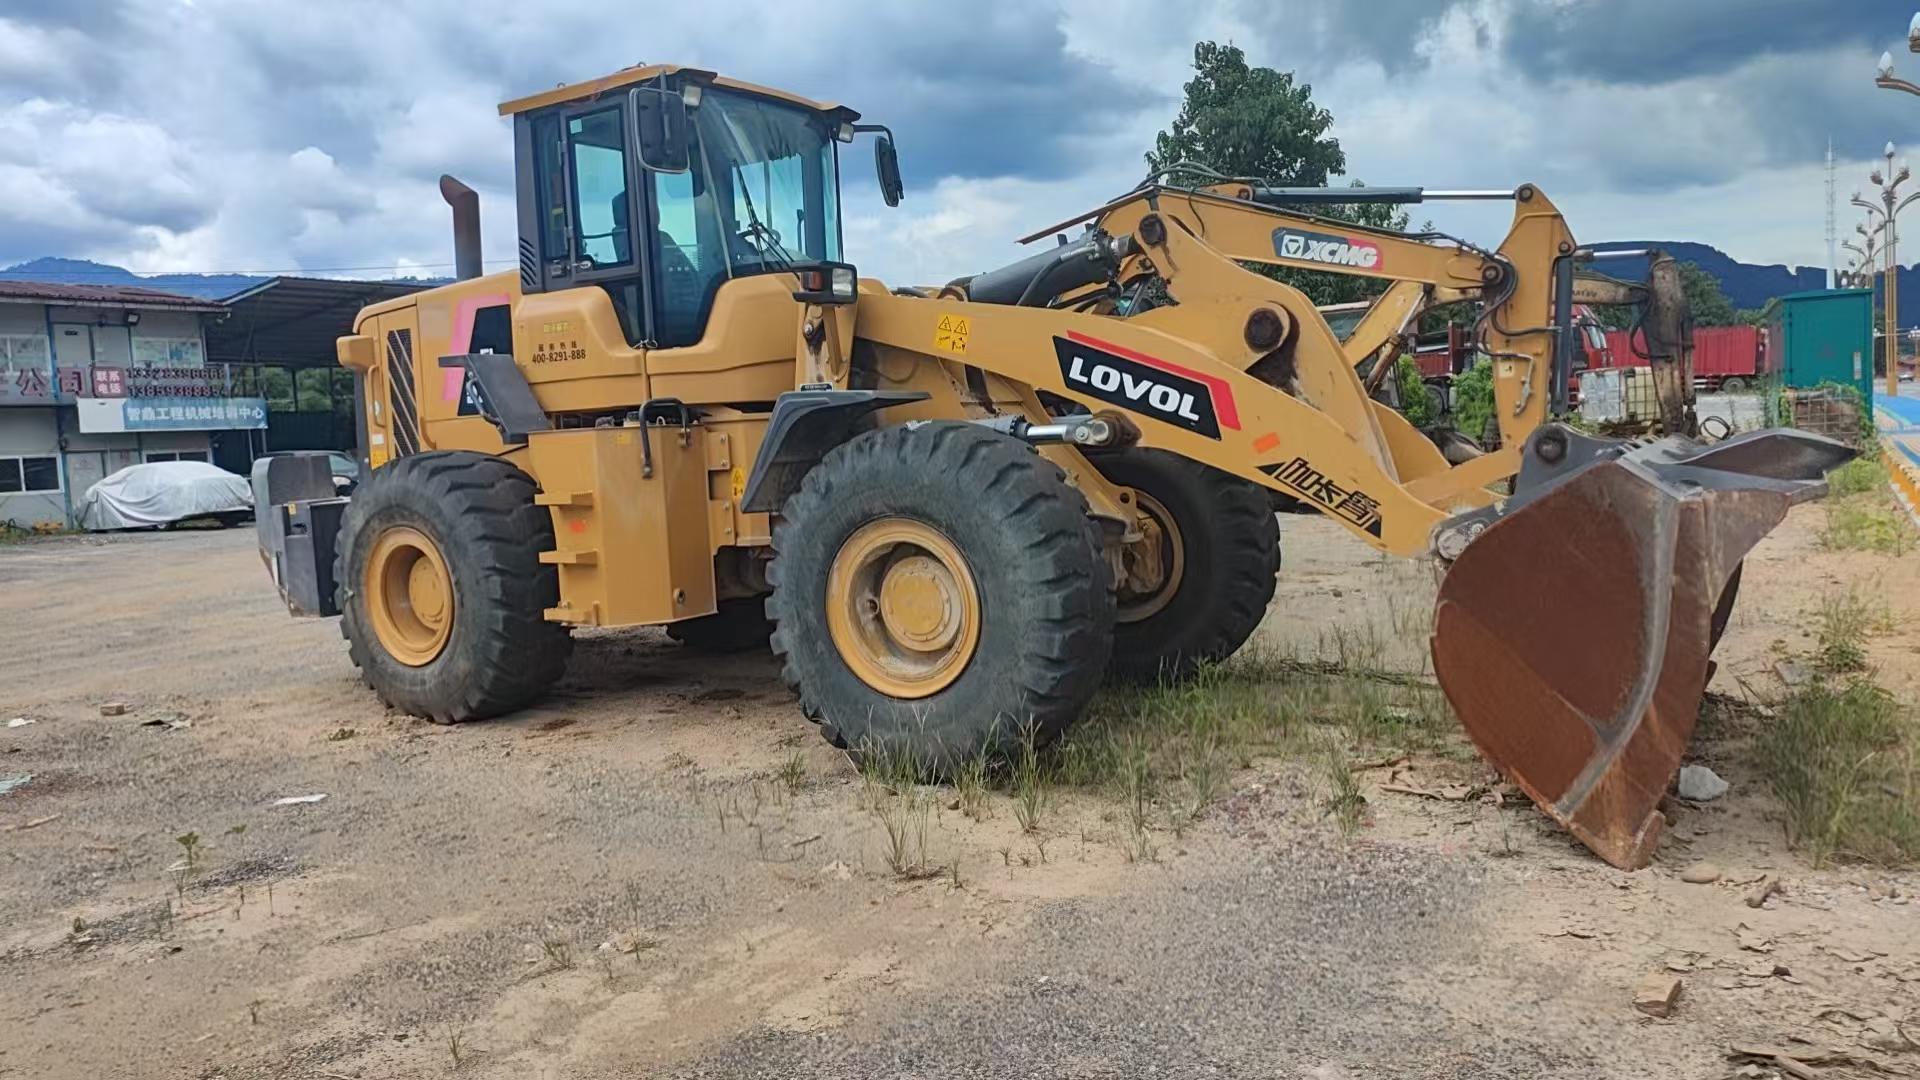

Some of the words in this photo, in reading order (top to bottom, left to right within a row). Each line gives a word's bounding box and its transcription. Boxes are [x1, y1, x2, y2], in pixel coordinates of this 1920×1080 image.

[1302, 239, 1378, 268] XCMG
[531, 349, 586, 364] 400-8291-888
[1068, 356, 1200, 422] LOVOL
